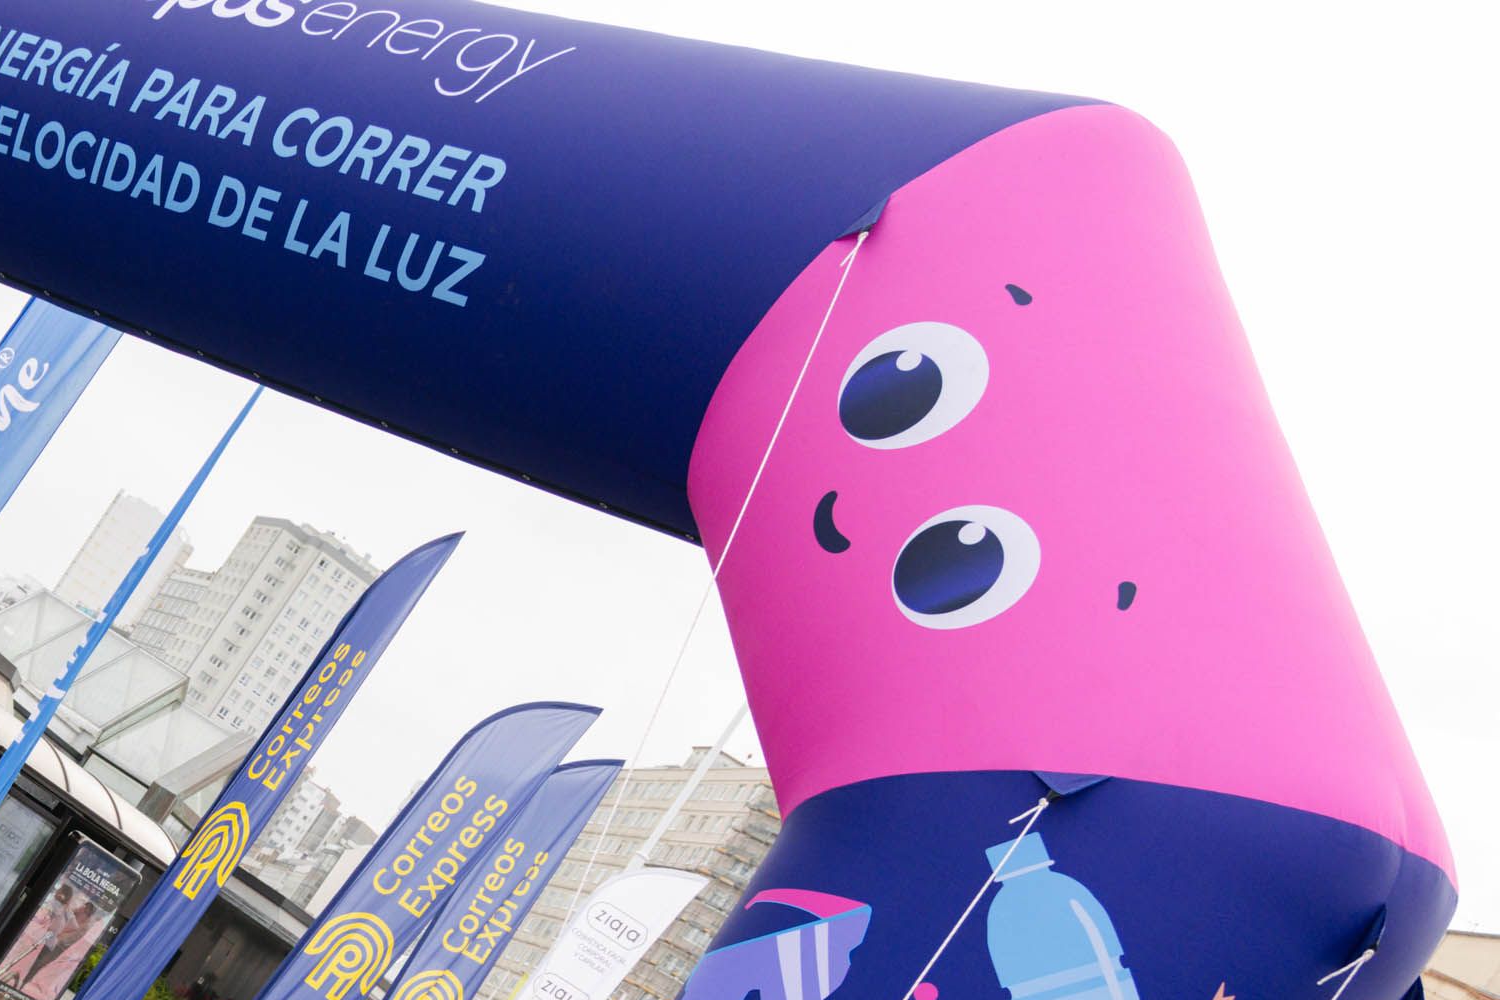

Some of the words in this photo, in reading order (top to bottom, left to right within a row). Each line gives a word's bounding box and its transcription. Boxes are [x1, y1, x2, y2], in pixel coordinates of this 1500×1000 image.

[301, 1, 577, 103] energy
[129, 68, 267, 147] PARA
[272, 107, 507, 213] CORRER
[207, 175, 282, 242] DE
[283, 199, 351, 268] LA
[363, 224, 486, 307] LUZ
[248, 643, 351, 780] Correos
[373, 776, 477, 896] Correos
[398, 795, 509, 918] Express
[442, 838, 525, 953] Correos
[461, 852, 549, 965] Express
[595, 910, 641, 943] ziaja
